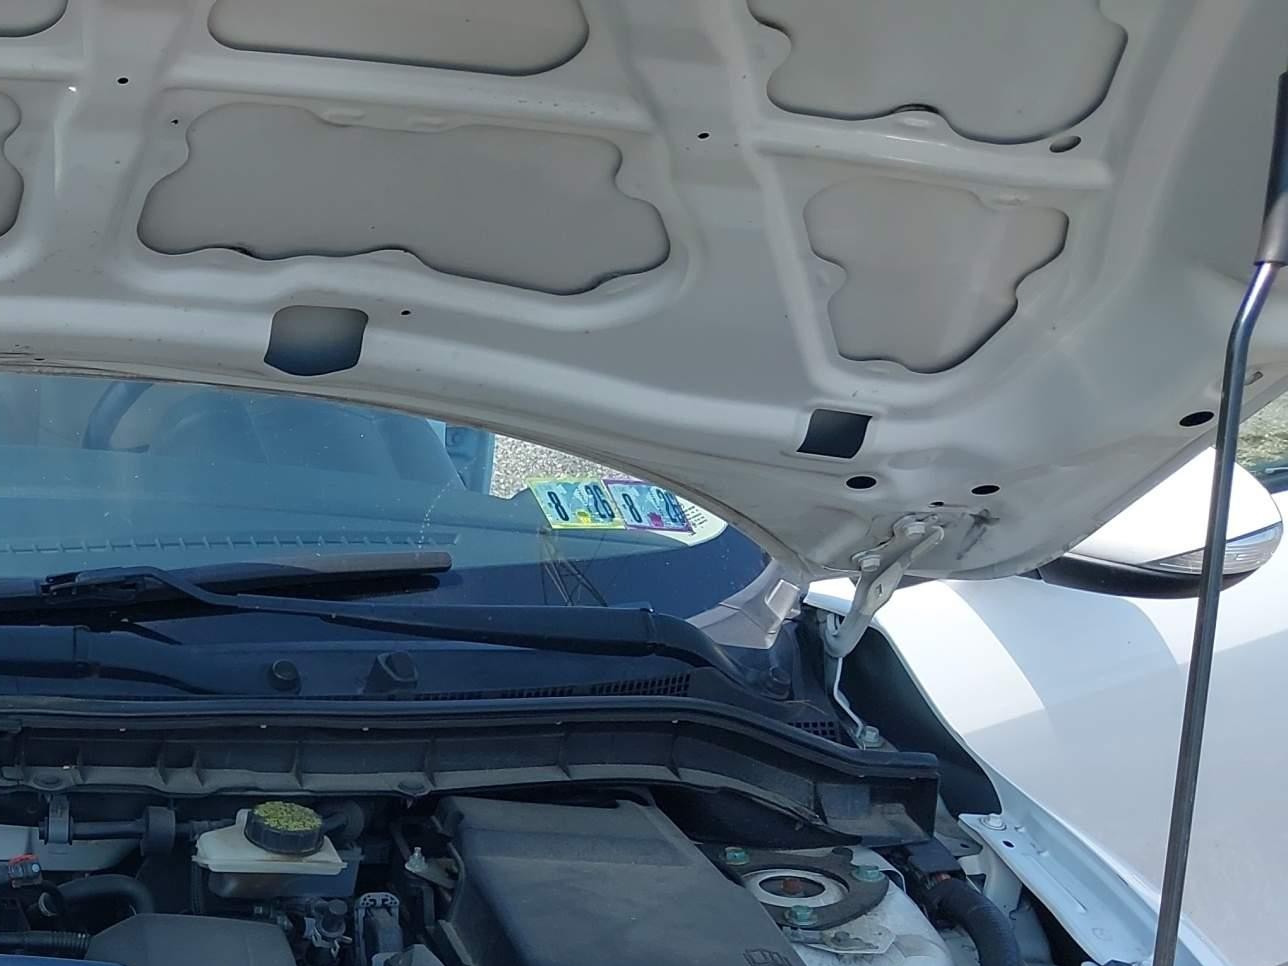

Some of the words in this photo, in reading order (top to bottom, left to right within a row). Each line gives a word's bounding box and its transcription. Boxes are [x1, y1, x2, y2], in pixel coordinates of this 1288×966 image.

[548, 491, 570, 522] 8
[585, 485, 615, 519] 26
[622, 493, 643, 523] 8
